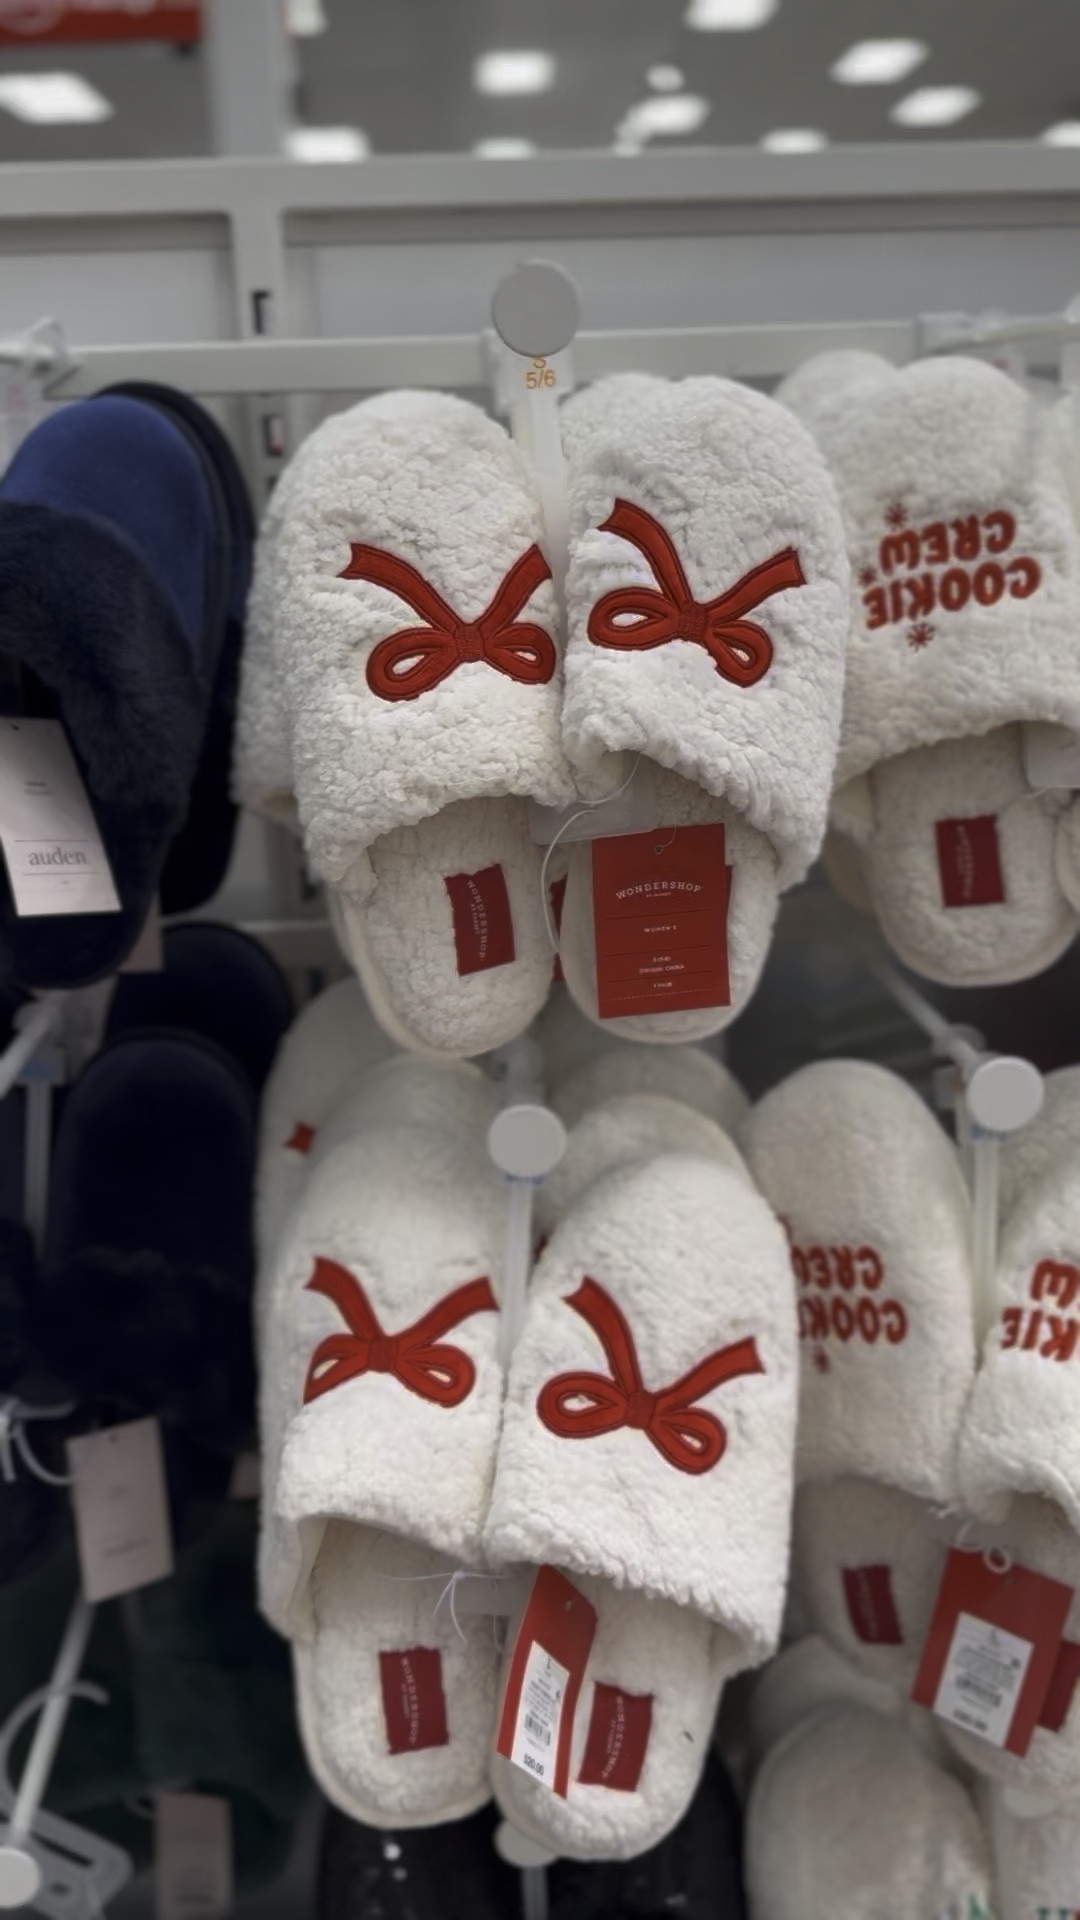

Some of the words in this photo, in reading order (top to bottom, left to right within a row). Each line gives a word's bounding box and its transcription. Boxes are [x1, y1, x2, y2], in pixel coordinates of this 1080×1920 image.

[526, 368, 556, 389] 5/6
[879, 509, 1017, 575] CREW
[862, 556, 1042, 630] COOKIE
[28, 846, 88, 867] auden
[615, 880, 703, 900] WONDERSHOP
